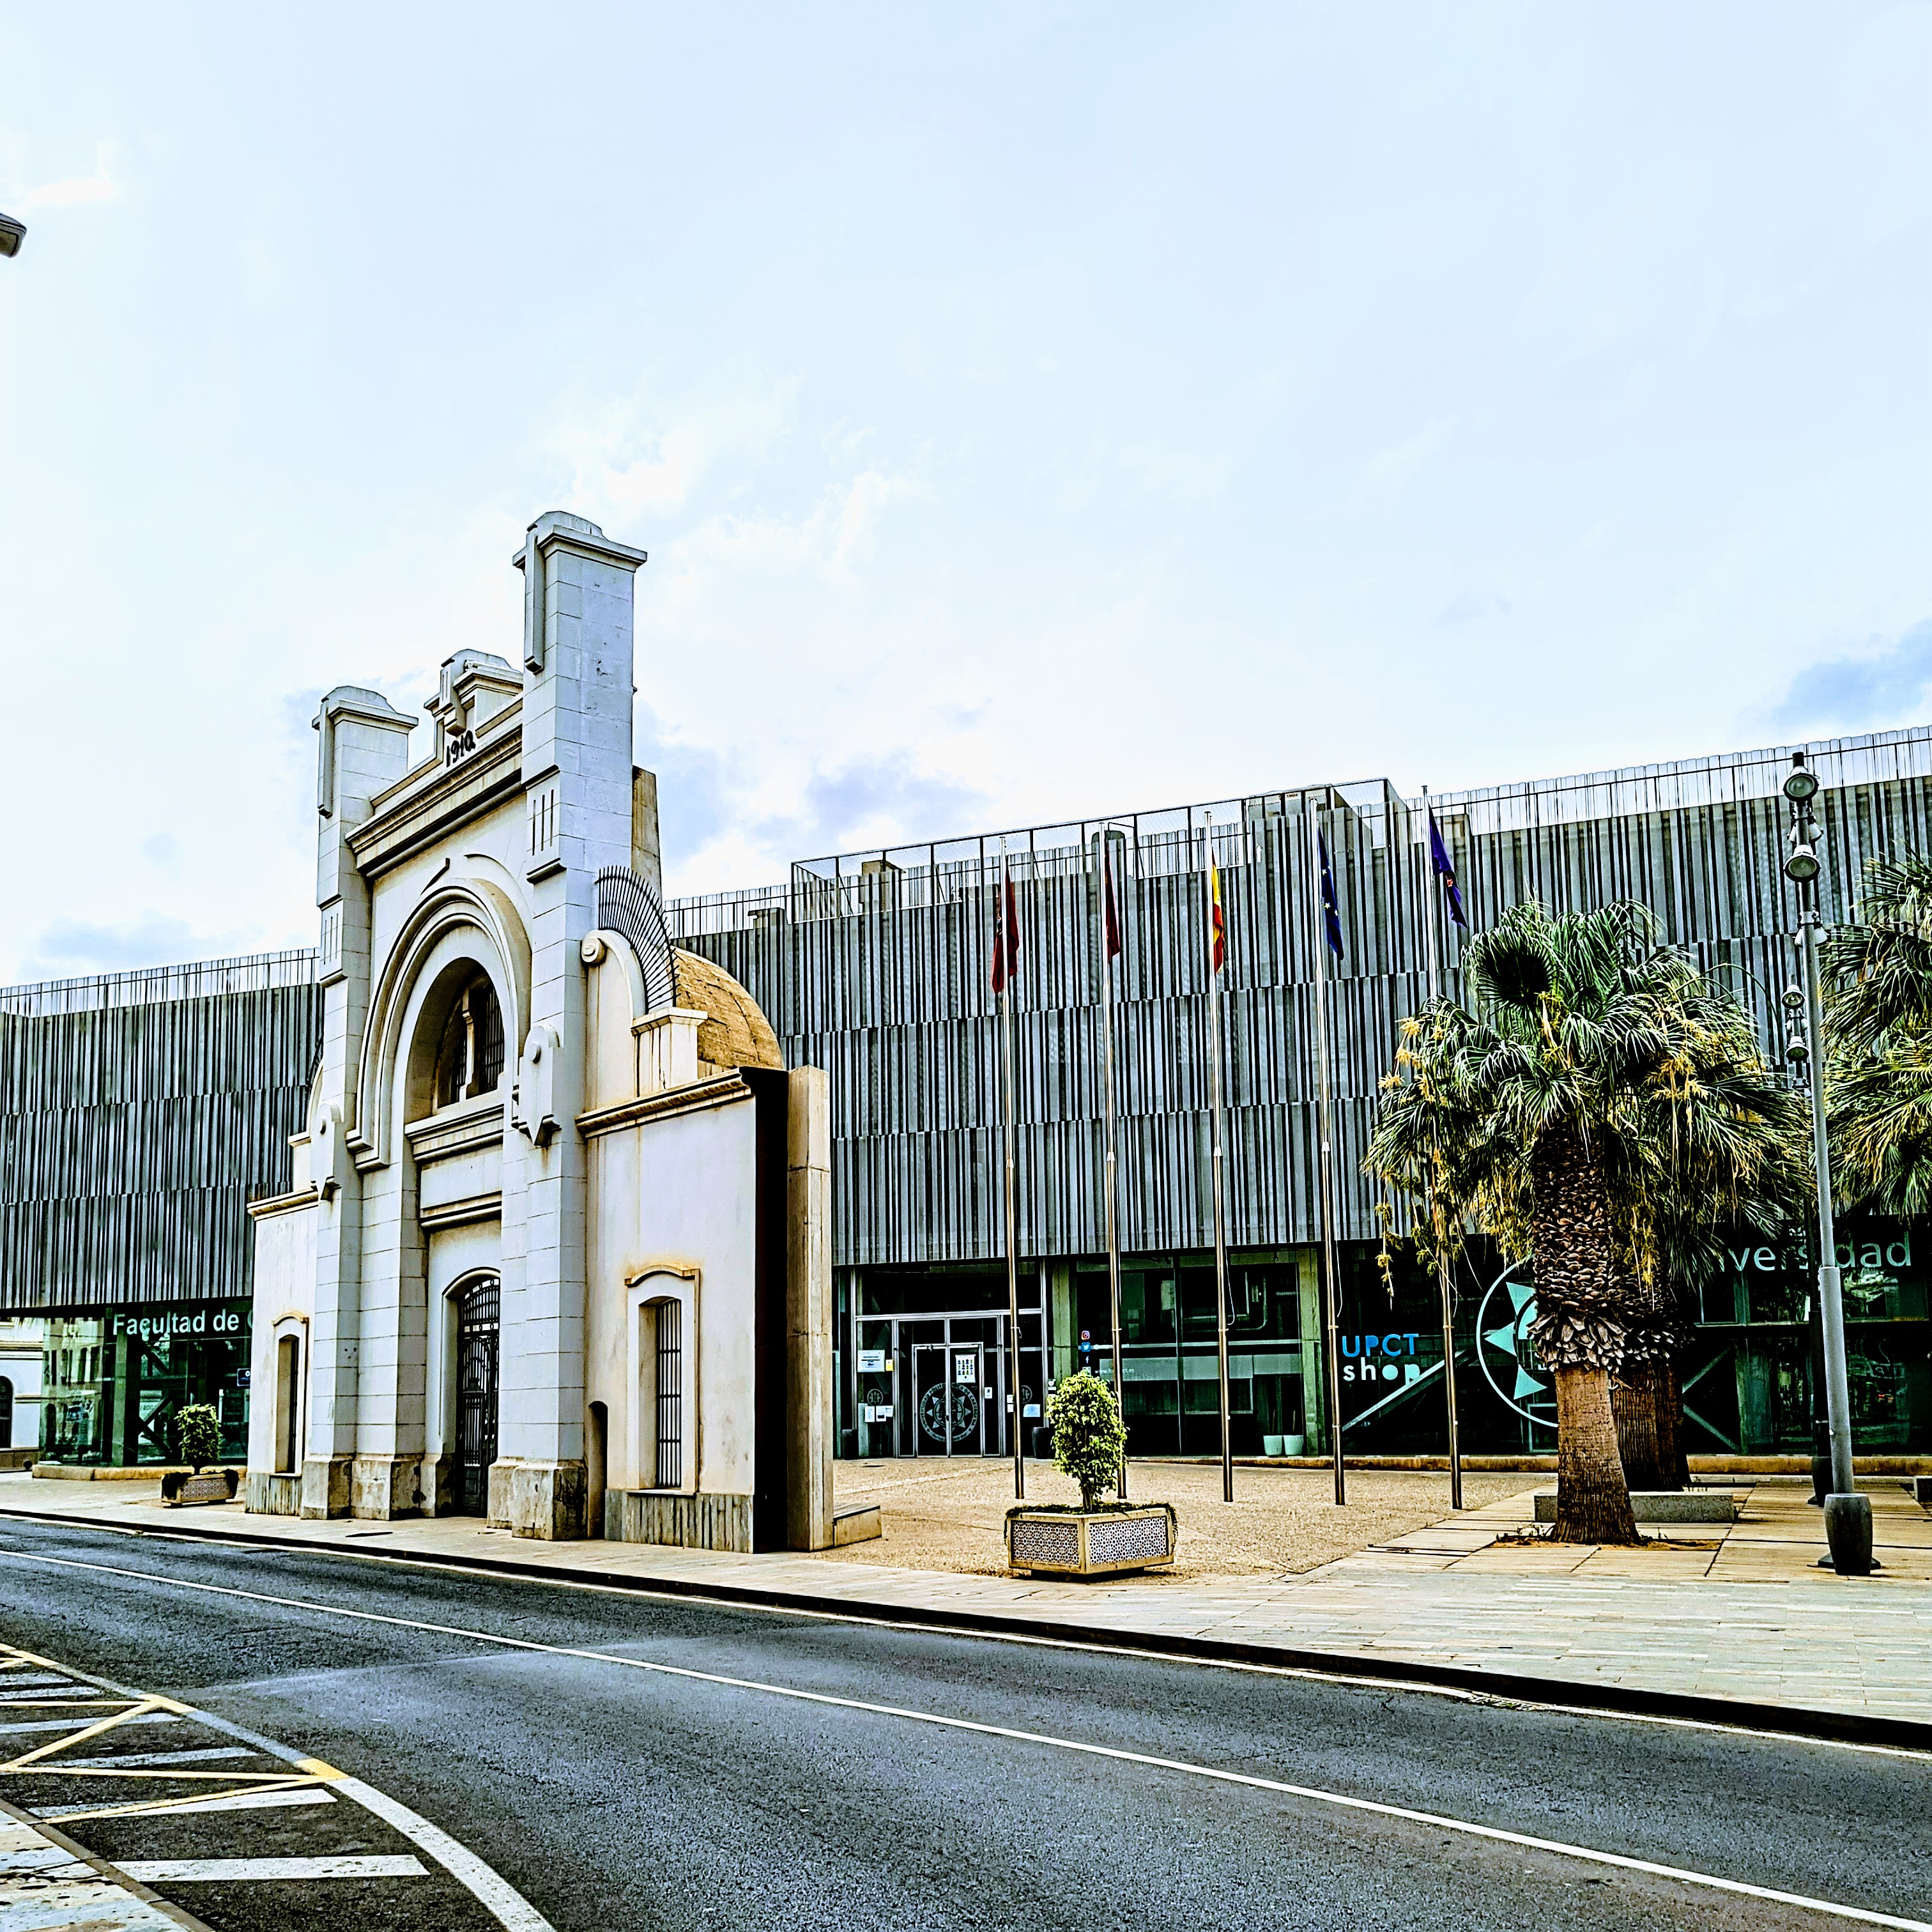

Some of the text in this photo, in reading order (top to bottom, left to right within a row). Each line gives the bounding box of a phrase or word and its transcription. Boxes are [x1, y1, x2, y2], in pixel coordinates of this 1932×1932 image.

[112, 1310, 205, 1336] Facultad
[213, 1308, 240, 1331] de
[1342, 1333, 1420, 1358] UPCT
[1342, 1356, 1420, 1388] shop
